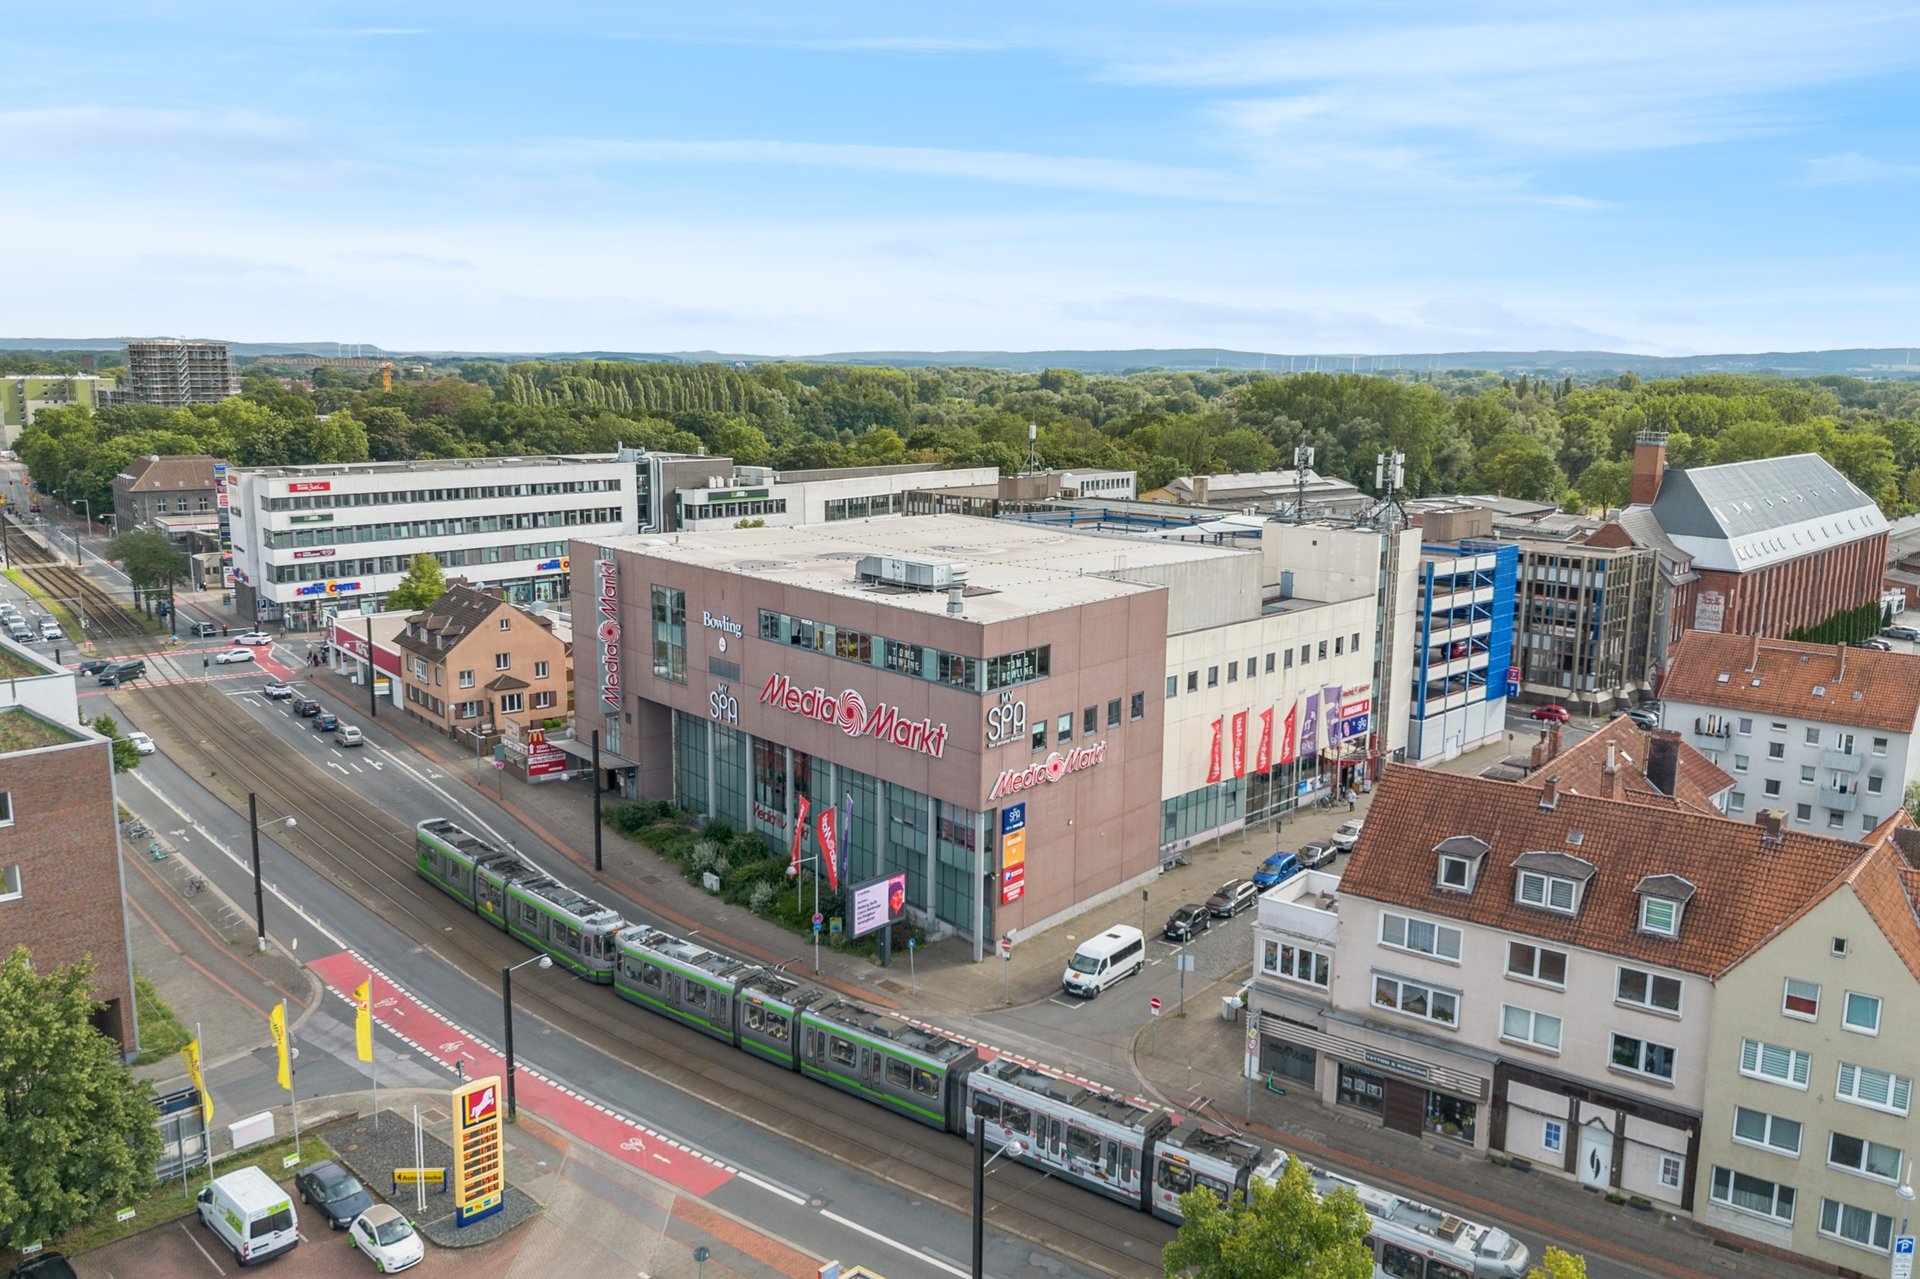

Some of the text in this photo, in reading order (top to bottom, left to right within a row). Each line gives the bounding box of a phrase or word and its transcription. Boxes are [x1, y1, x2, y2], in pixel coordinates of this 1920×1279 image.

[703, 610, 742, 638] Bowling
[718, 684, 728, 693] MY
[1001, 691, 1013, 703] MY
[710, 691, 739, 725] SPA
[759, 672, 949, 759] Media Markt
[987, 700, 1026, 741] SPA
[989, 740, 1108, 800] Media Markt
[1366, 1054, 1390, 1065] TATTOO
